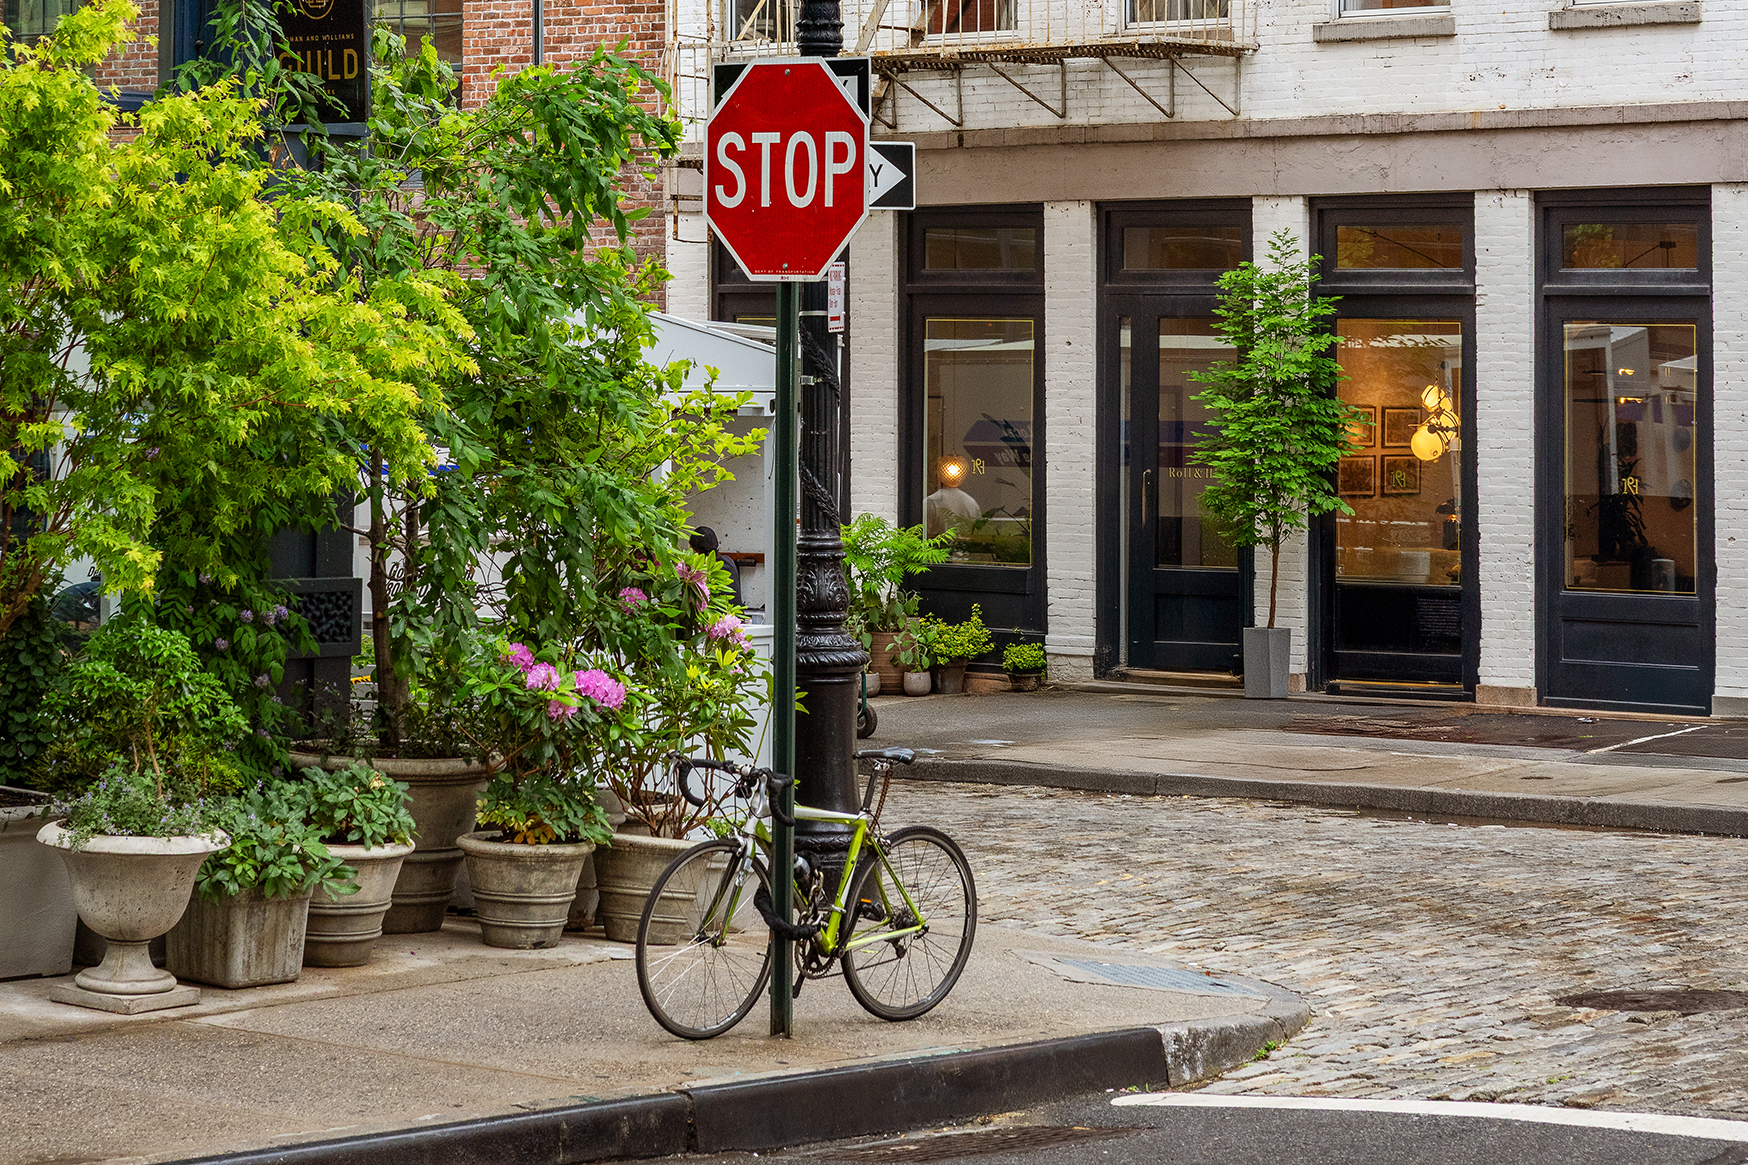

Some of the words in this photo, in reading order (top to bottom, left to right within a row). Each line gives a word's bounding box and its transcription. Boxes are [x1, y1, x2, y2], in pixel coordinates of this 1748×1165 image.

[306, 34, 320, 42] AND
[322, 33, 355, 41] WILLIAMS
[278, 48, 359, 82] GUILD
[715, 130, 857, 208] STOP
